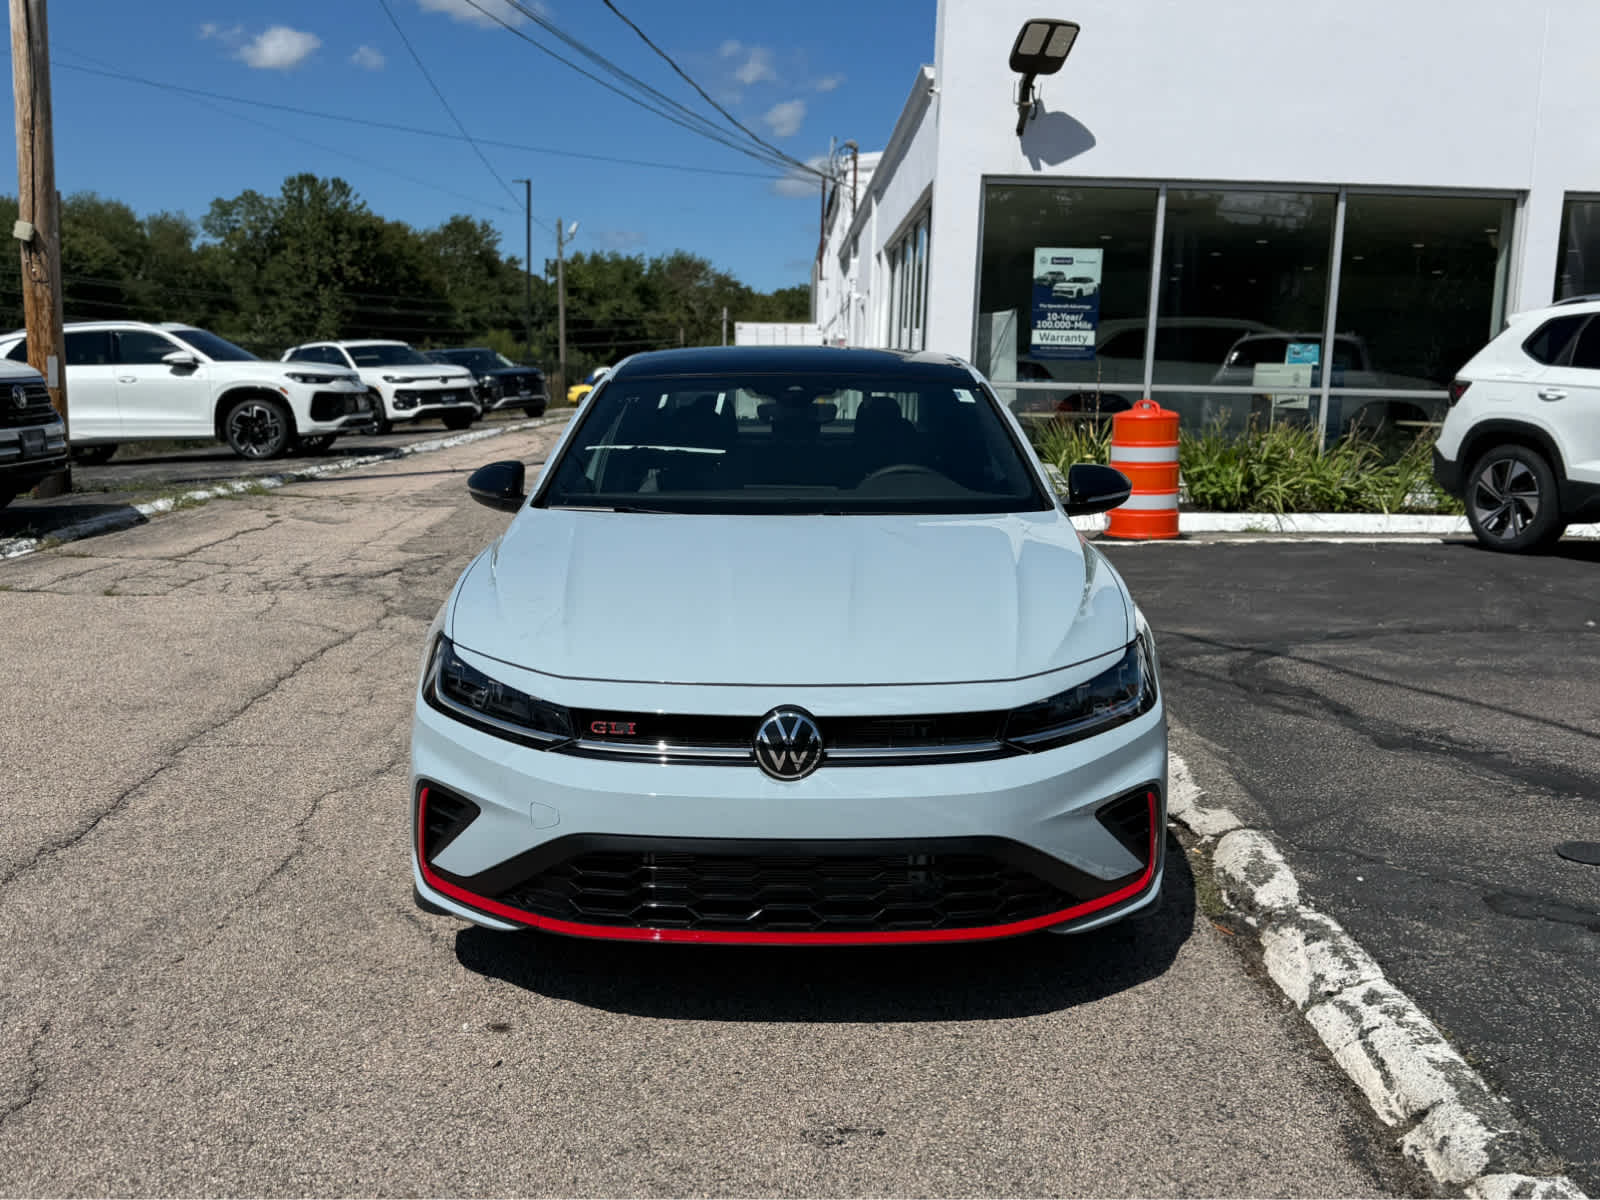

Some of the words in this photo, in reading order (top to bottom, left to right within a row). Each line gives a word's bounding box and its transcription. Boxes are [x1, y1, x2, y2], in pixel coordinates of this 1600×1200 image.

[1047, 312, 1084, 321] 10-Year/
[1039, 331, 1088, 345] Warranty
[591, 720, 636, 735] GLI
